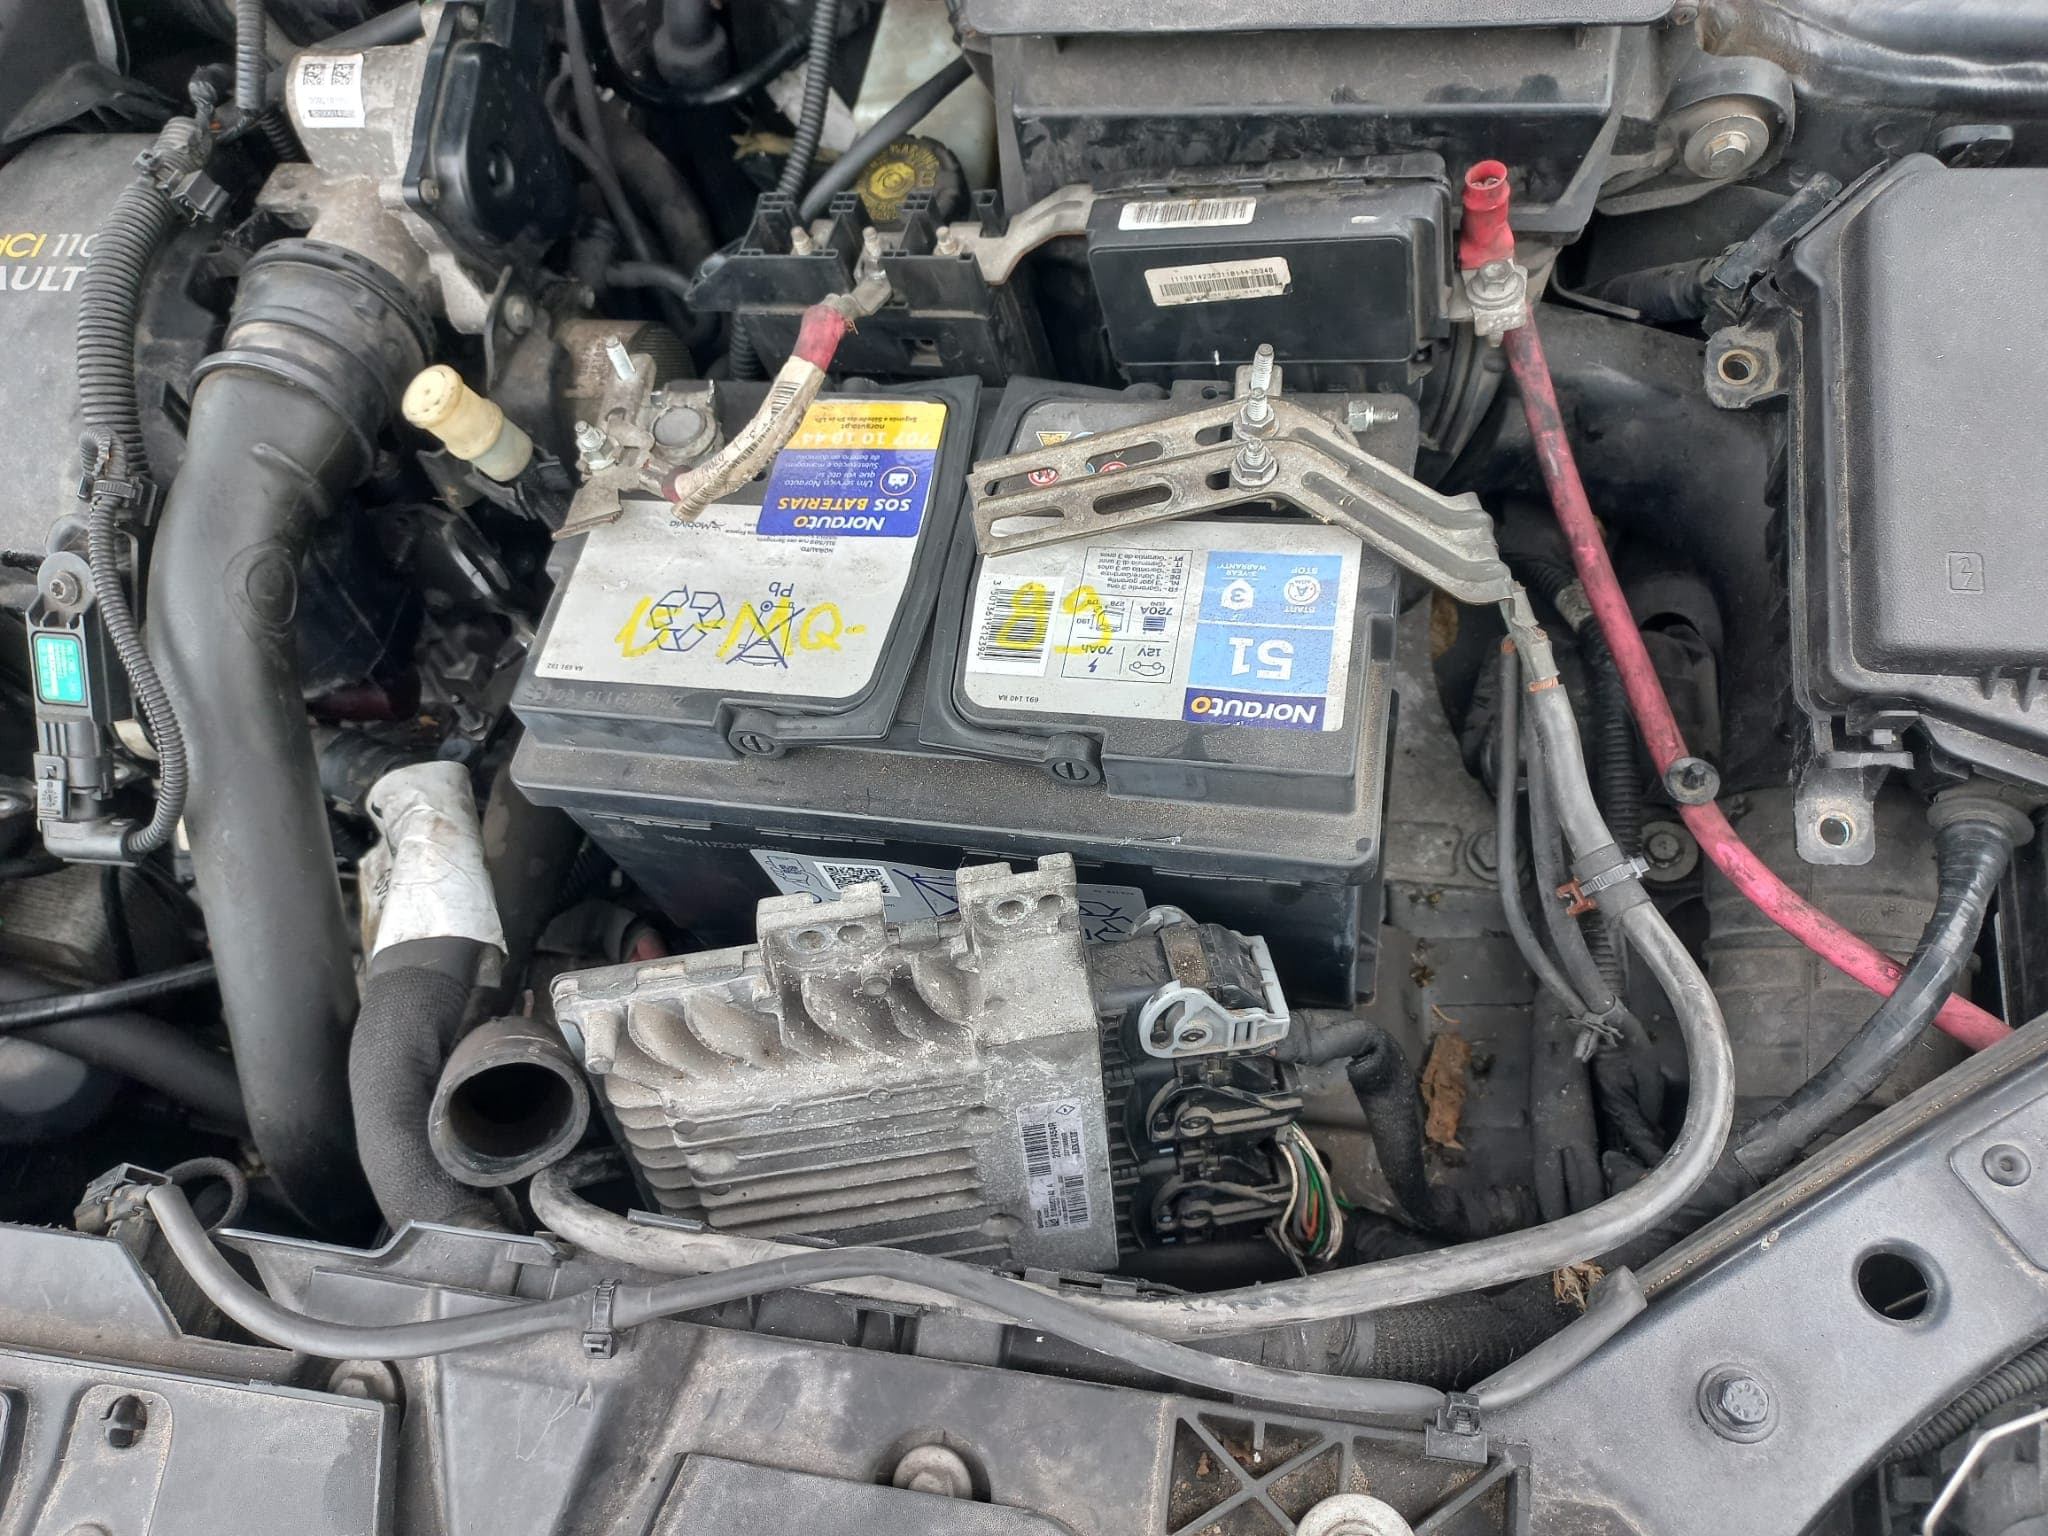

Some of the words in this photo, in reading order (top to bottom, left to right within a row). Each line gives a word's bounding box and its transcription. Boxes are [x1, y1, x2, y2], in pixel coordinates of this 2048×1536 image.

[862, 432, 886, 444] 10
[784, 480, 821, 488] Norauto
[824, 479, 855, 487] serviço
[857, 480, 873, 488] Um
[778, 498, 869, 510] BATERIAS
[874, 498, 912, 511] SOS
[793, 516, 885, 530] Norauto
[1290, 566, 1318, 574] STOP
[769, 581, 795, 598] Pb
[1230, 588, 1246, 603] 3
[1140, 606, 1173, 616] 720A
[1081, 644, 1114, 655] 70Ah
[1137, 648, 1162, 657] 12V
[1228, 637, 1295, 681] 51
[1191, 696, 1317, 724] Norauto
